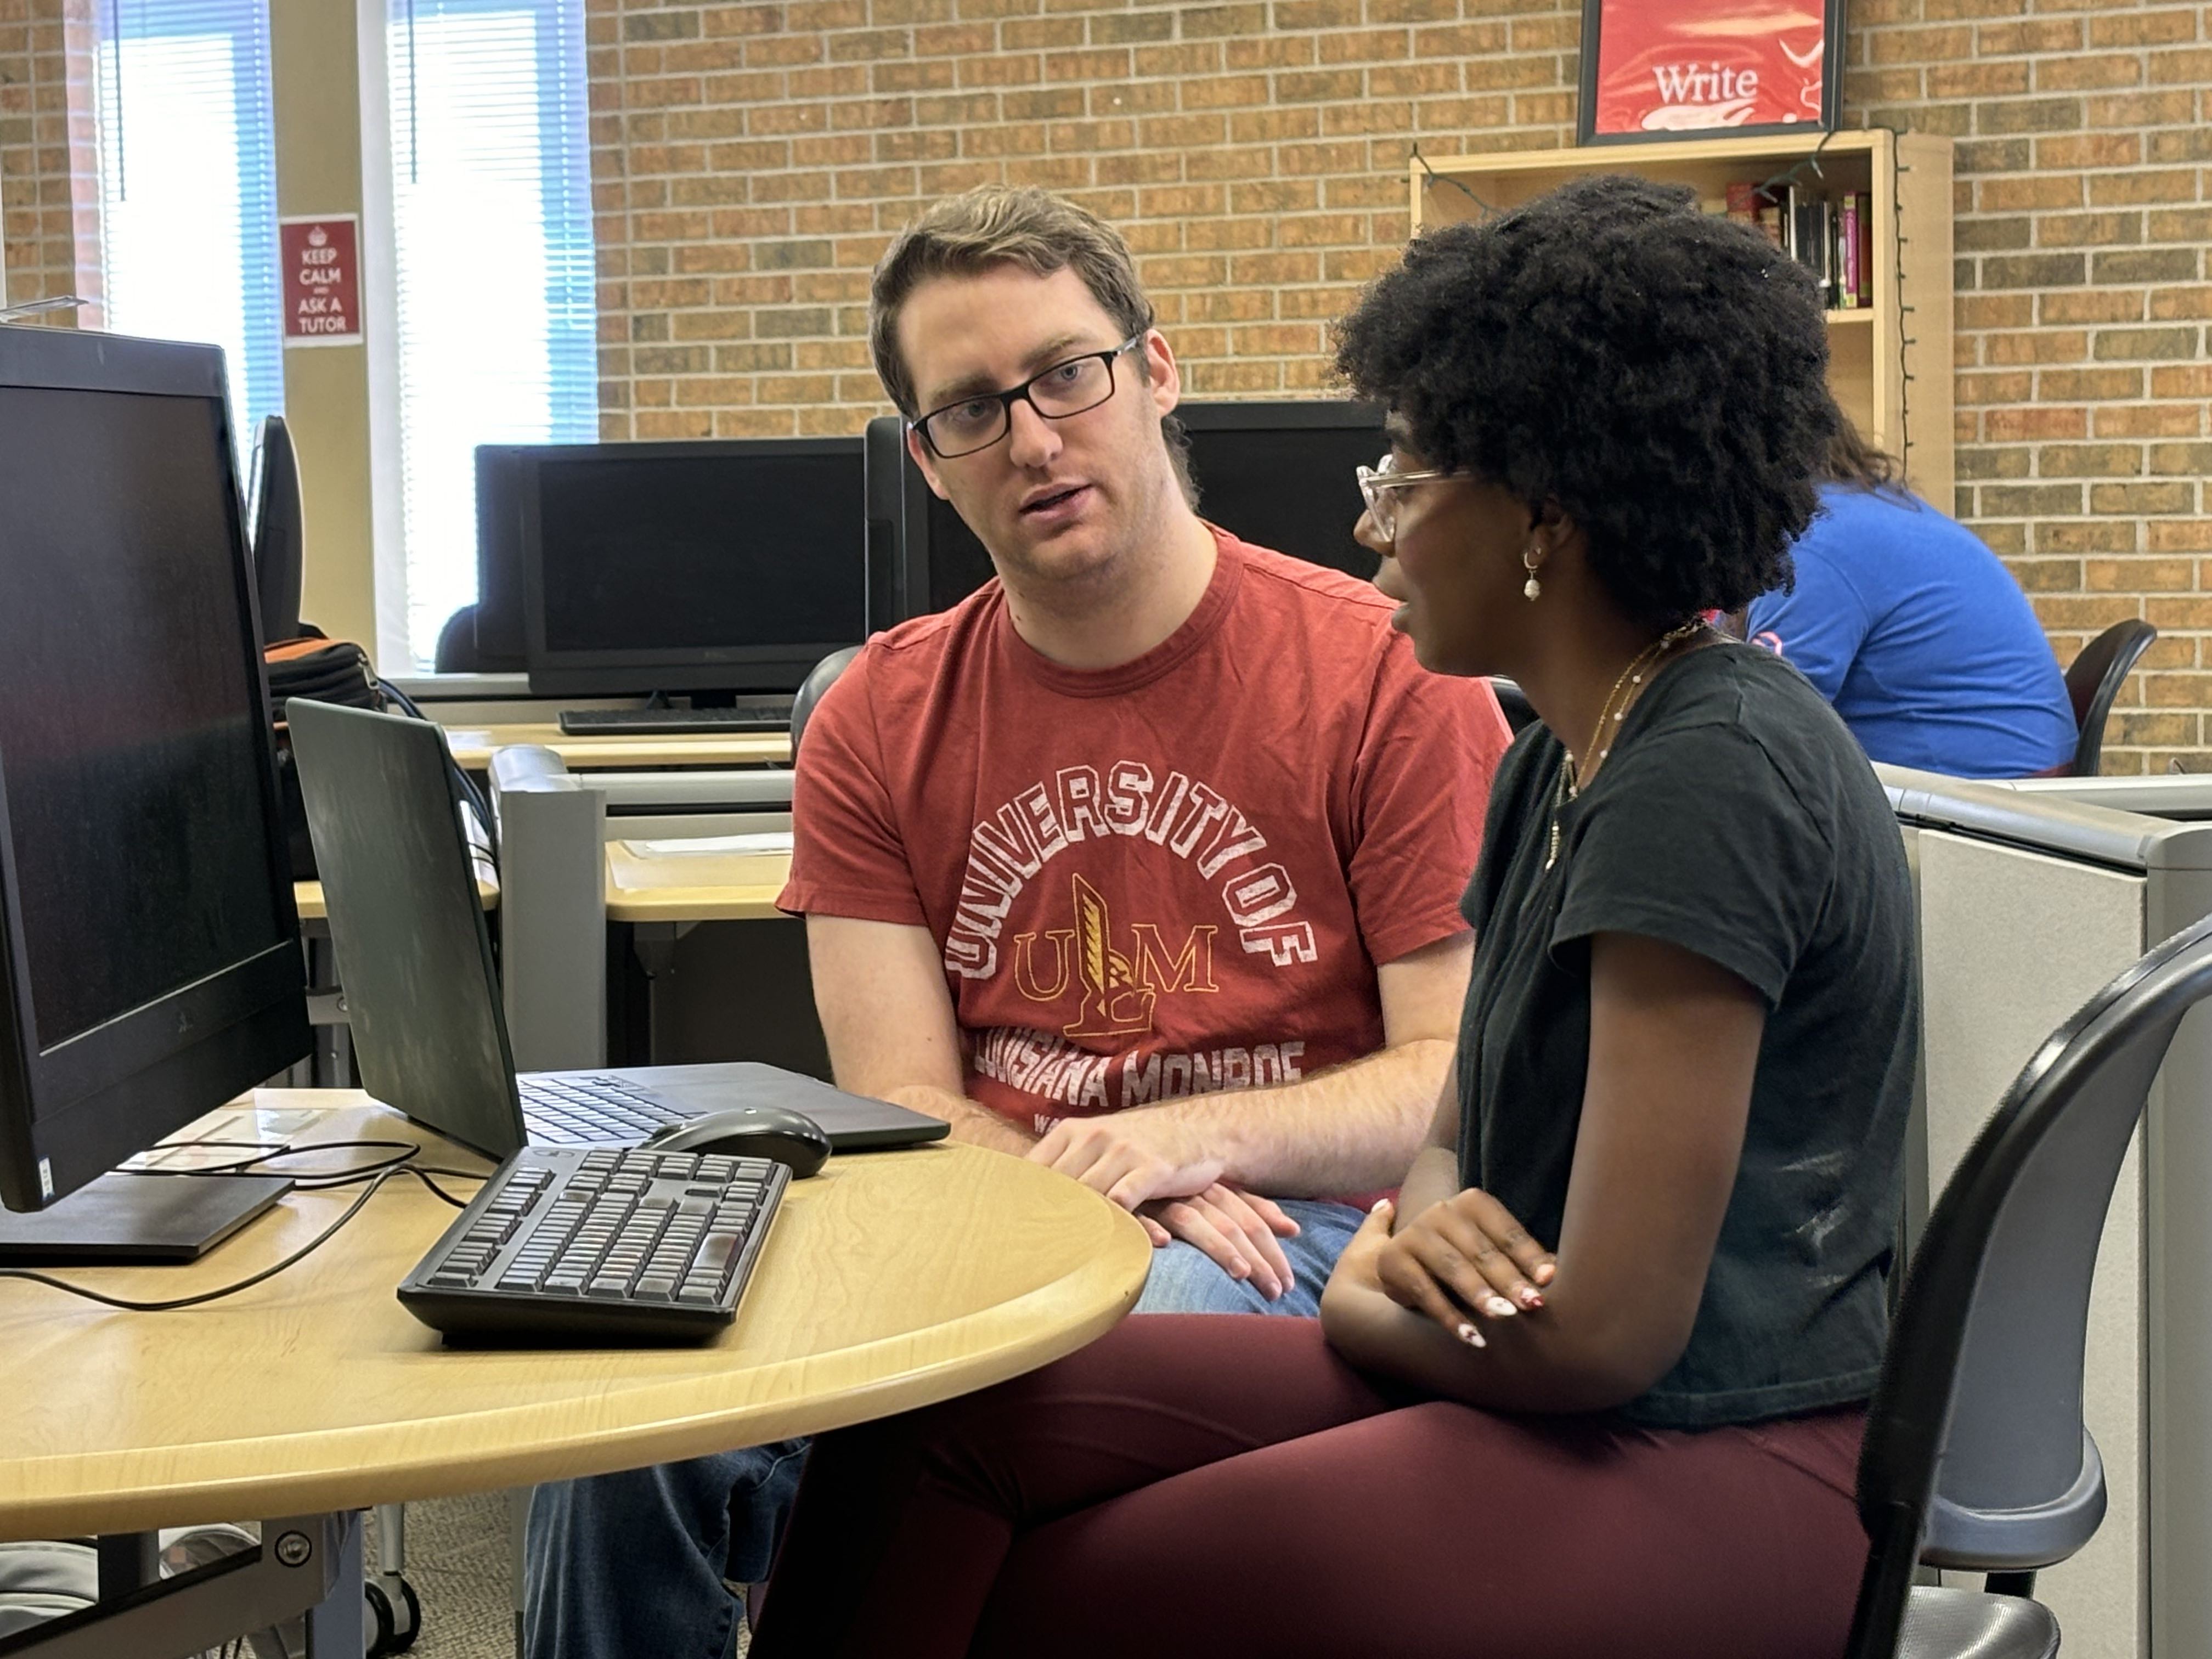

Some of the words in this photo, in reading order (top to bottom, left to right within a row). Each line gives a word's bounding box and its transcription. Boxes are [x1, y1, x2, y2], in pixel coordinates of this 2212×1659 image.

[1652, 61, 1758, 104] Write
[302, 248, 337, 264] KEEP
[300, 268, 341, 285] CALM
[298, 298, 327, 314] ASK
[330, 297, 342, 313] A
[298, 316, 346, 334] TUTOR
[944, 760, 1267, 980] UNIVERSITY
[1221, 862, 1318, 967] OF
[1121, 1041, 1305, 1107] MONROE
